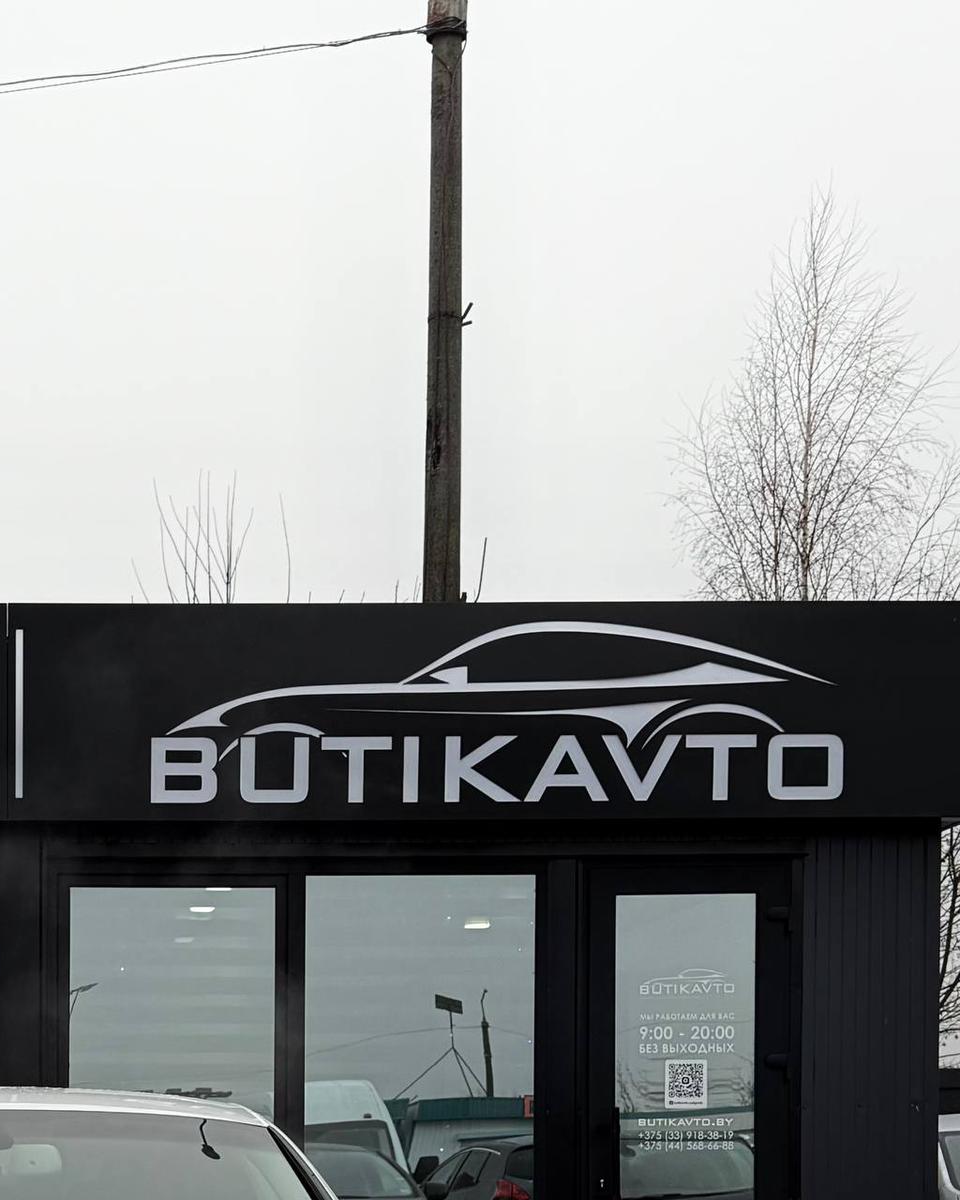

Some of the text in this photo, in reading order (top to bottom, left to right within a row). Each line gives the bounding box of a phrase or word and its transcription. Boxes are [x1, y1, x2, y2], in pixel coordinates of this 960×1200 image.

[150, 733, 844, 804] BUTIKAVTO
[639, 983, 735, 995] BUTIKAVTO
[639, 1012, 735, 1021] МЫ РАБОТАЕМ ДЛЯ ВАС
[639, 1025, 673, 1041] 9:00
[690, 1025, 735, 1041] 20:00
[639, 1043, 735, 1055] БЕЗ ВЫХОДНЫХ
[638, 1118, 734, 1128] BUTIKAVTO.BY
[638, 1130, 734, 1141] +375 (33) 918-38-19
[638, 1141, 735, 1152] +375 (44) 568-66-88
